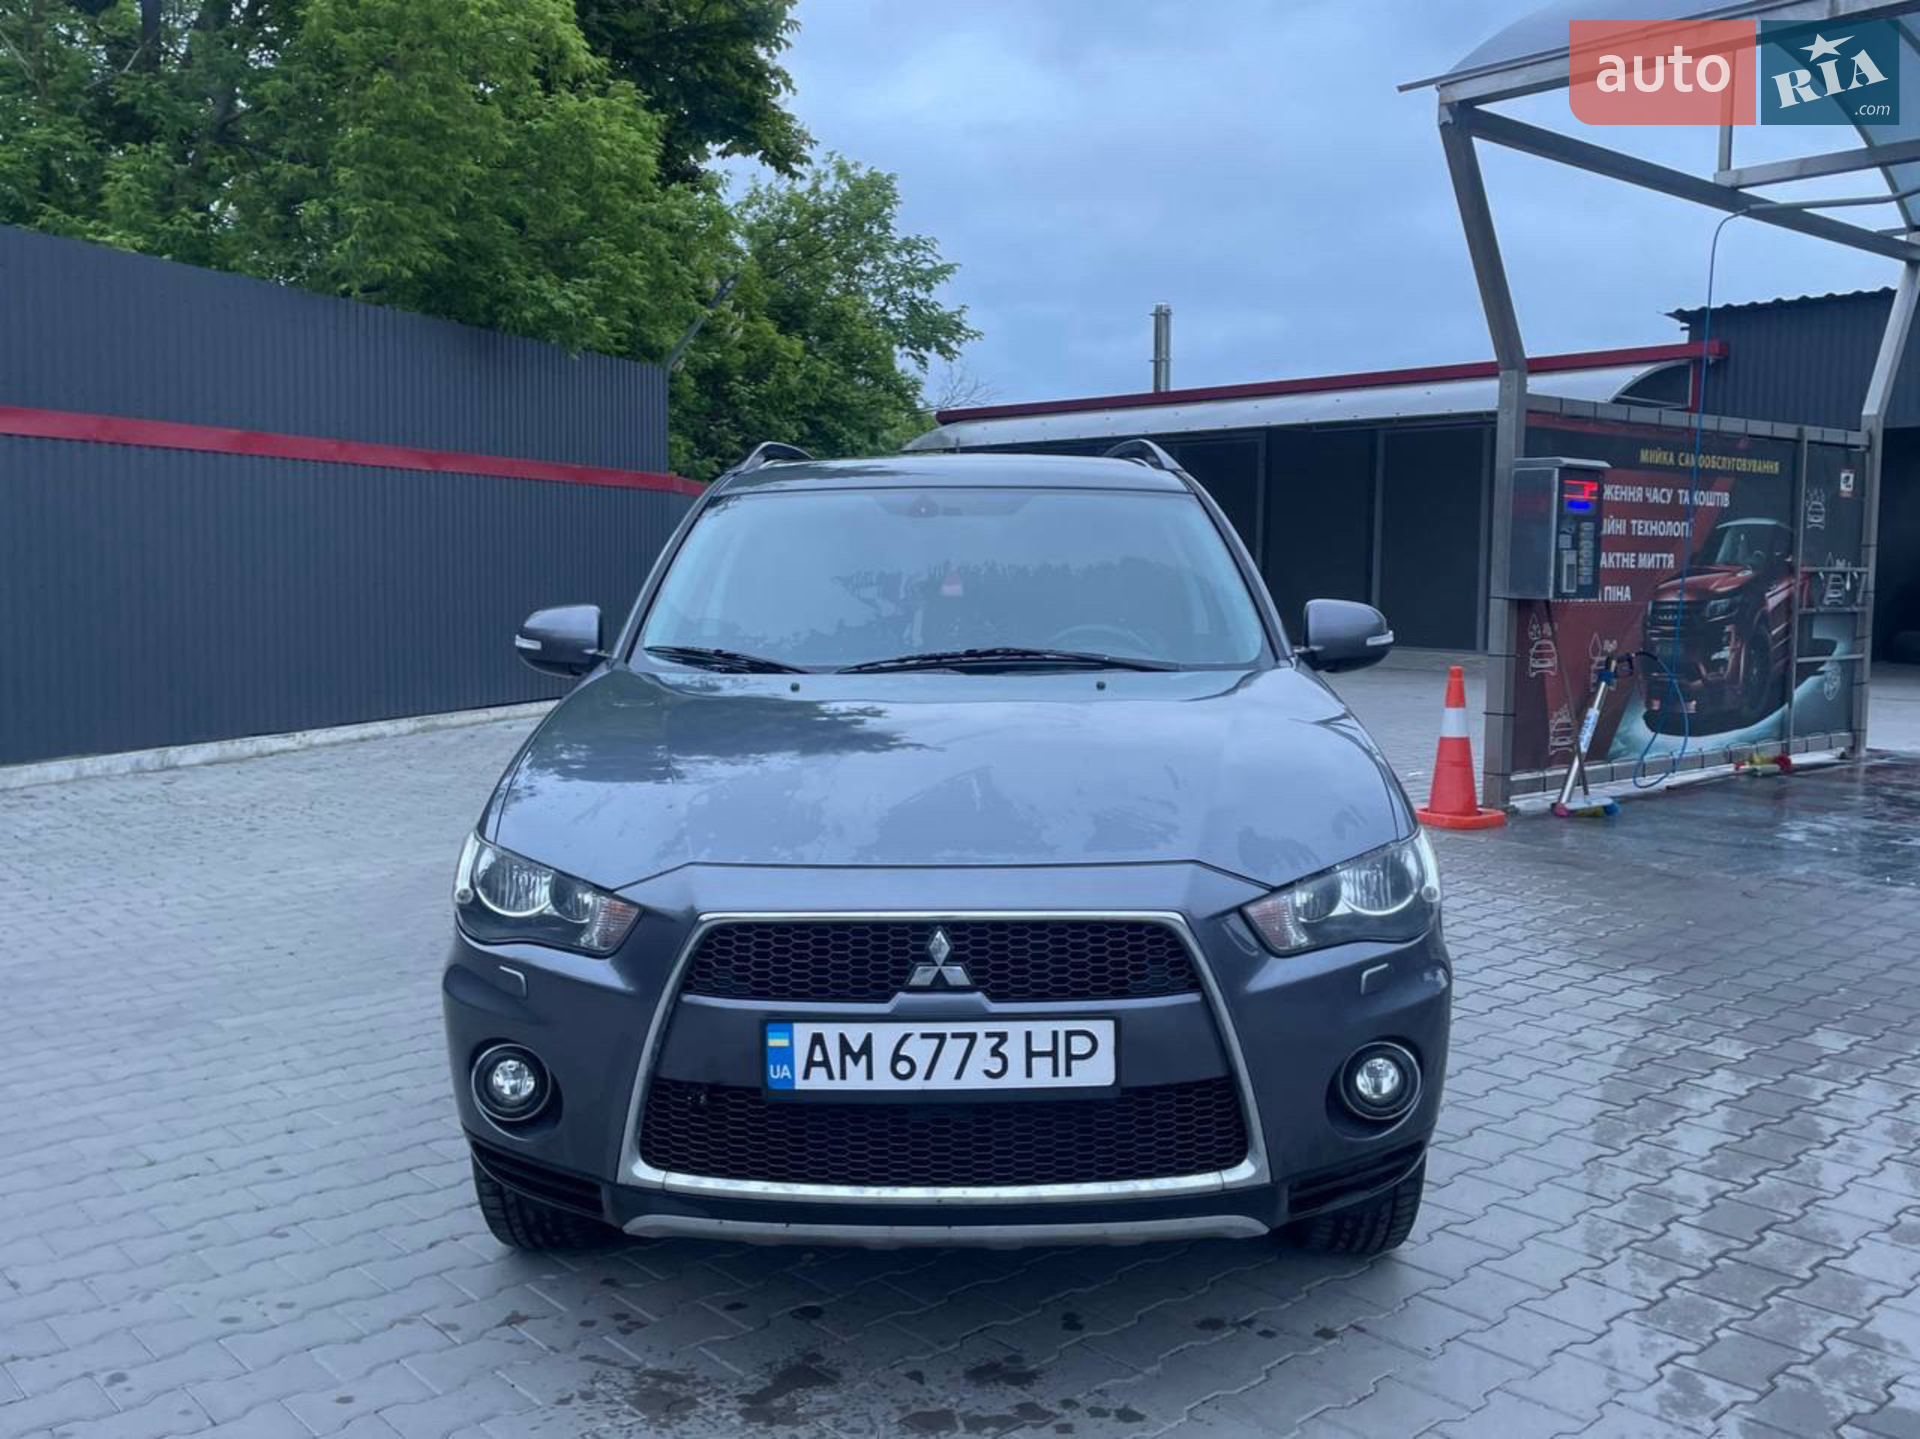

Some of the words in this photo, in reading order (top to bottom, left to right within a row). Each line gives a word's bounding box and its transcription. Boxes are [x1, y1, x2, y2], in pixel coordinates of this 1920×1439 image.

[1640, 447, 1675, 466] МИЙКА
[1645, 487, 1673, 505] ЧАСУ
[1678, 489, 1690, 505] ТА
[1631, 519, 1693, 538] ТЕХНОЛОГІ
[1638, 552, 1675, 569] МИТТЯ
[1604, 585, 1632, 602] ПІНА
[770, 1064, 791, 1080] UA
[802, 1032, 874, 1081] AM
[889, 1032, 1009, 1082] 6773
[1025, 1029, 1099, 1079] HP
